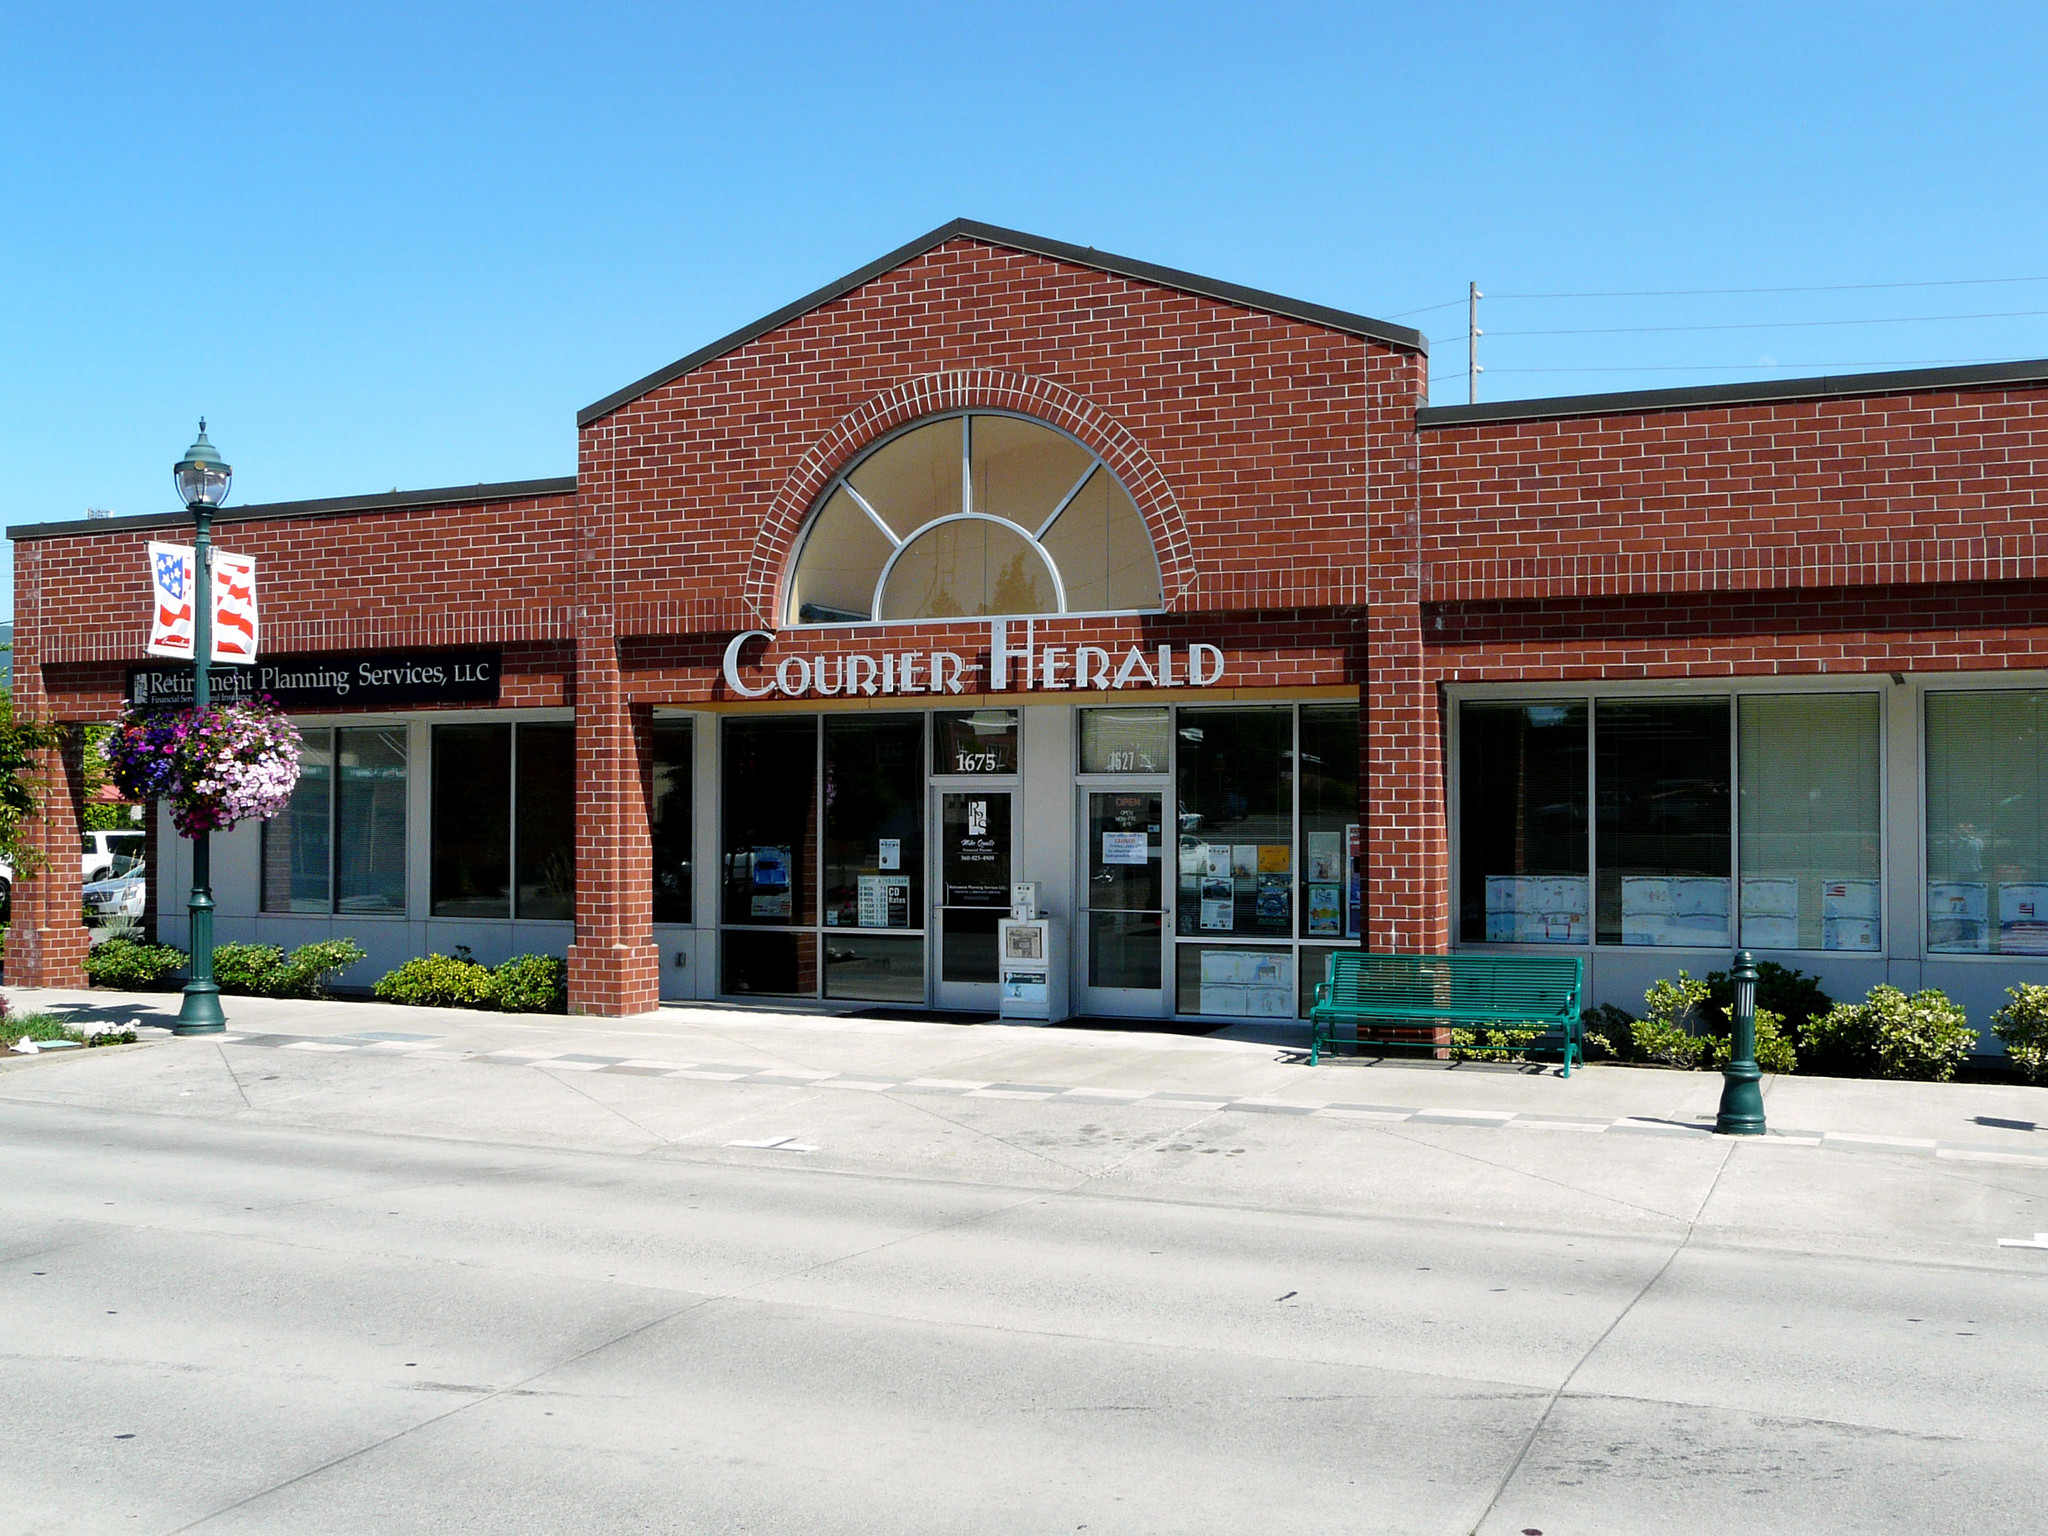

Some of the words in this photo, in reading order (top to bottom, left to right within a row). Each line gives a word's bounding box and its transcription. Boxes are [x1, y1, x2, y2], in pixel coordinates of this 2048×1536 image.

[150, 672, 254, 694] Retirment
[260, 666, 351, 695] Planning
[358, 661, 448, 686] Services,
[454, 663, 490, 682] LLC
[955, 753, 996, 772] 1675
[1115, 797, 1141, 807] OPEN
[889, 886, 900, 896] CD
